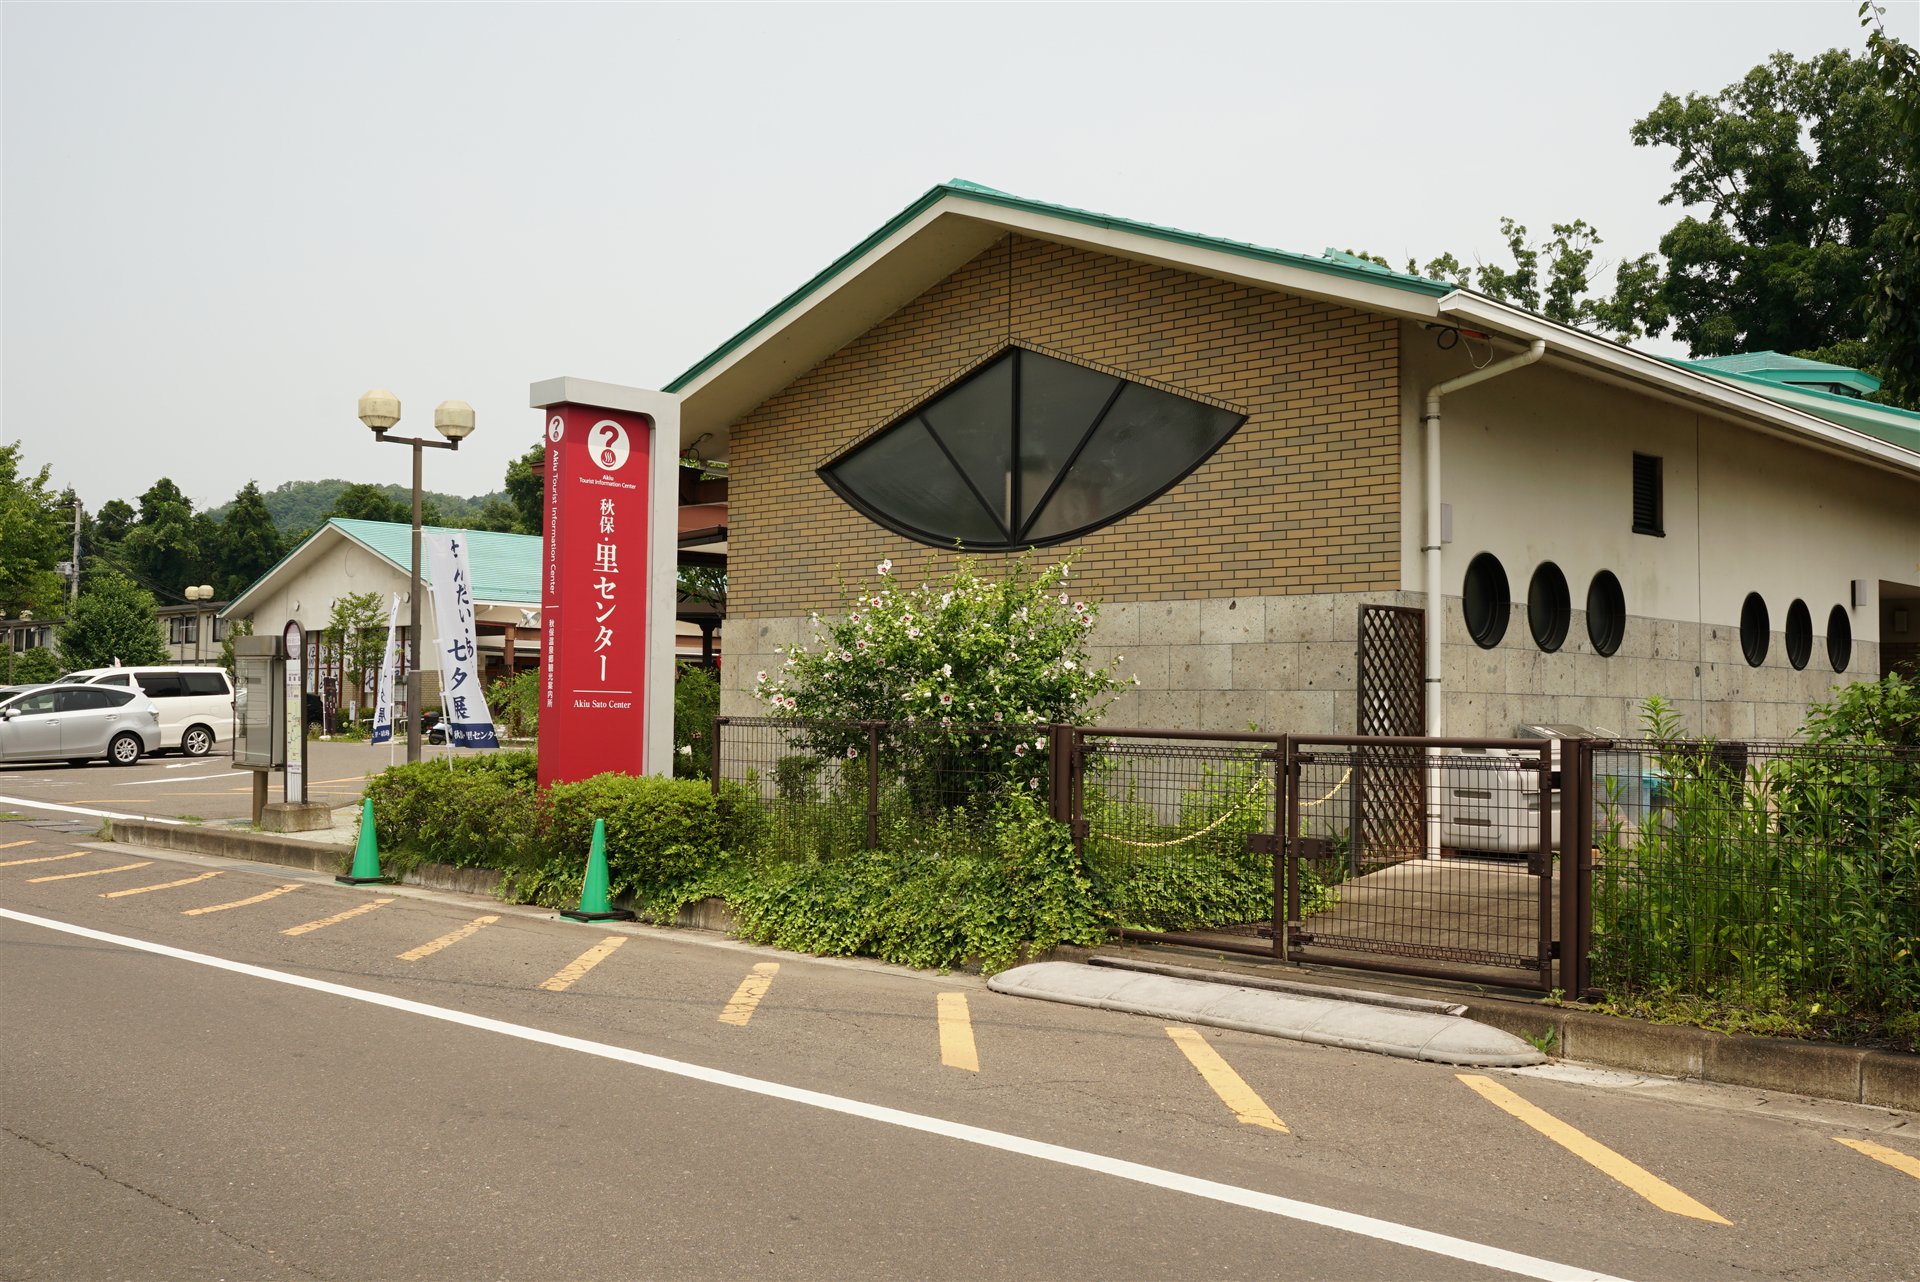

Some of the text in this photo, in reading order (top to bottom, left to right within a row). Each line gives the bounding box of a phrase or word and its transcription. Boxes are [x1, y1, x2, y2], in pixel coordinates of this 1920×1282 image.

[579, 477, 637, 490] Tourist Information Center
[550, 507, 558, 562] Information
[549, 564, 557, 595] Center
[593, 498, 619, 682] 秋保・里センター
[447, 639, 470, 721] 七夕展
[573, 699, 632, 710] Akiu Sato Center
